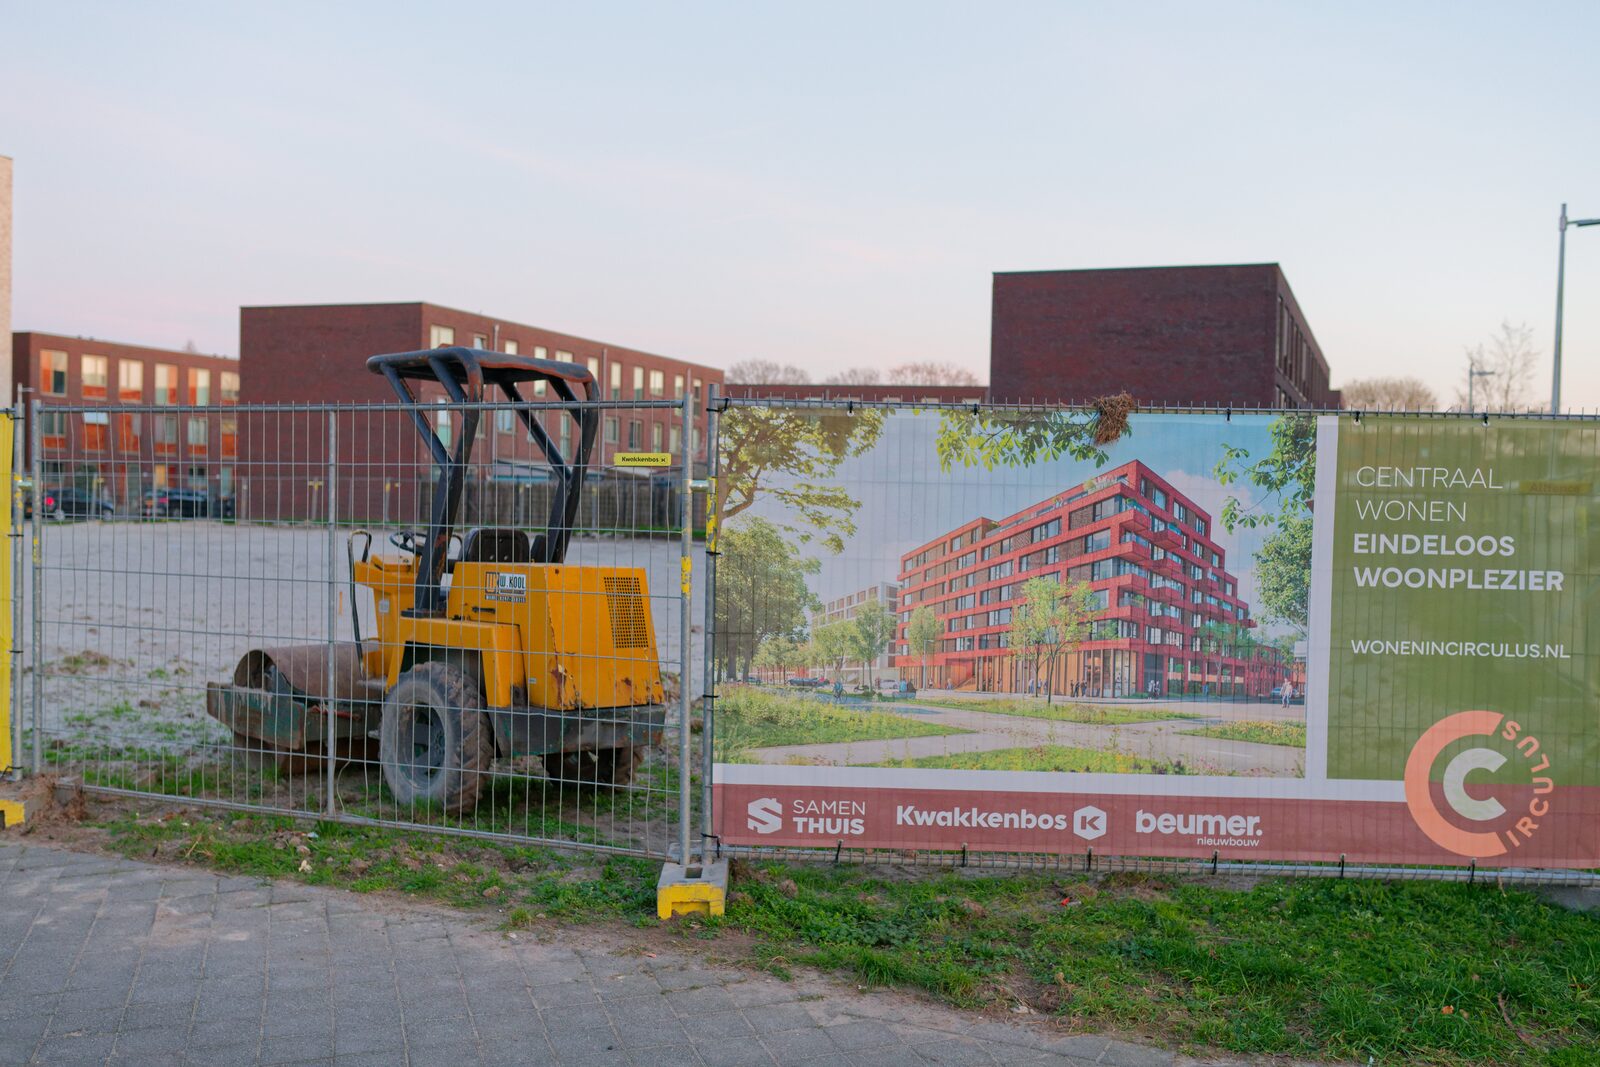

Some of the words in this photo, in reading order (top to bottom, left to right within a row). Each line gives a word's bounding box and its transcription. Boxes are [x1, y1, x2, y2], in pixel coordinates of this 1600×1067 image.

[1356, 466, 1503, 489] CENTRAAL
[1355, 499, 1466, 522] WONEN
[1353, 533, 1515, 557] EINDELOOS
[1353, 566, 1564, 591] WOONPLEZIER
[1351, 639, 1571, 659] WONENINCIRCULUS.NL
[792, 799, 866, 816] SAMEN
[896, 805, 1067, 830] Kwakkenbos
[792, 817, 865, 835] THUIS
[1136, 809, 1263, 836] beumer.
[1197, 836, 1259, 847] nieuwbouw
